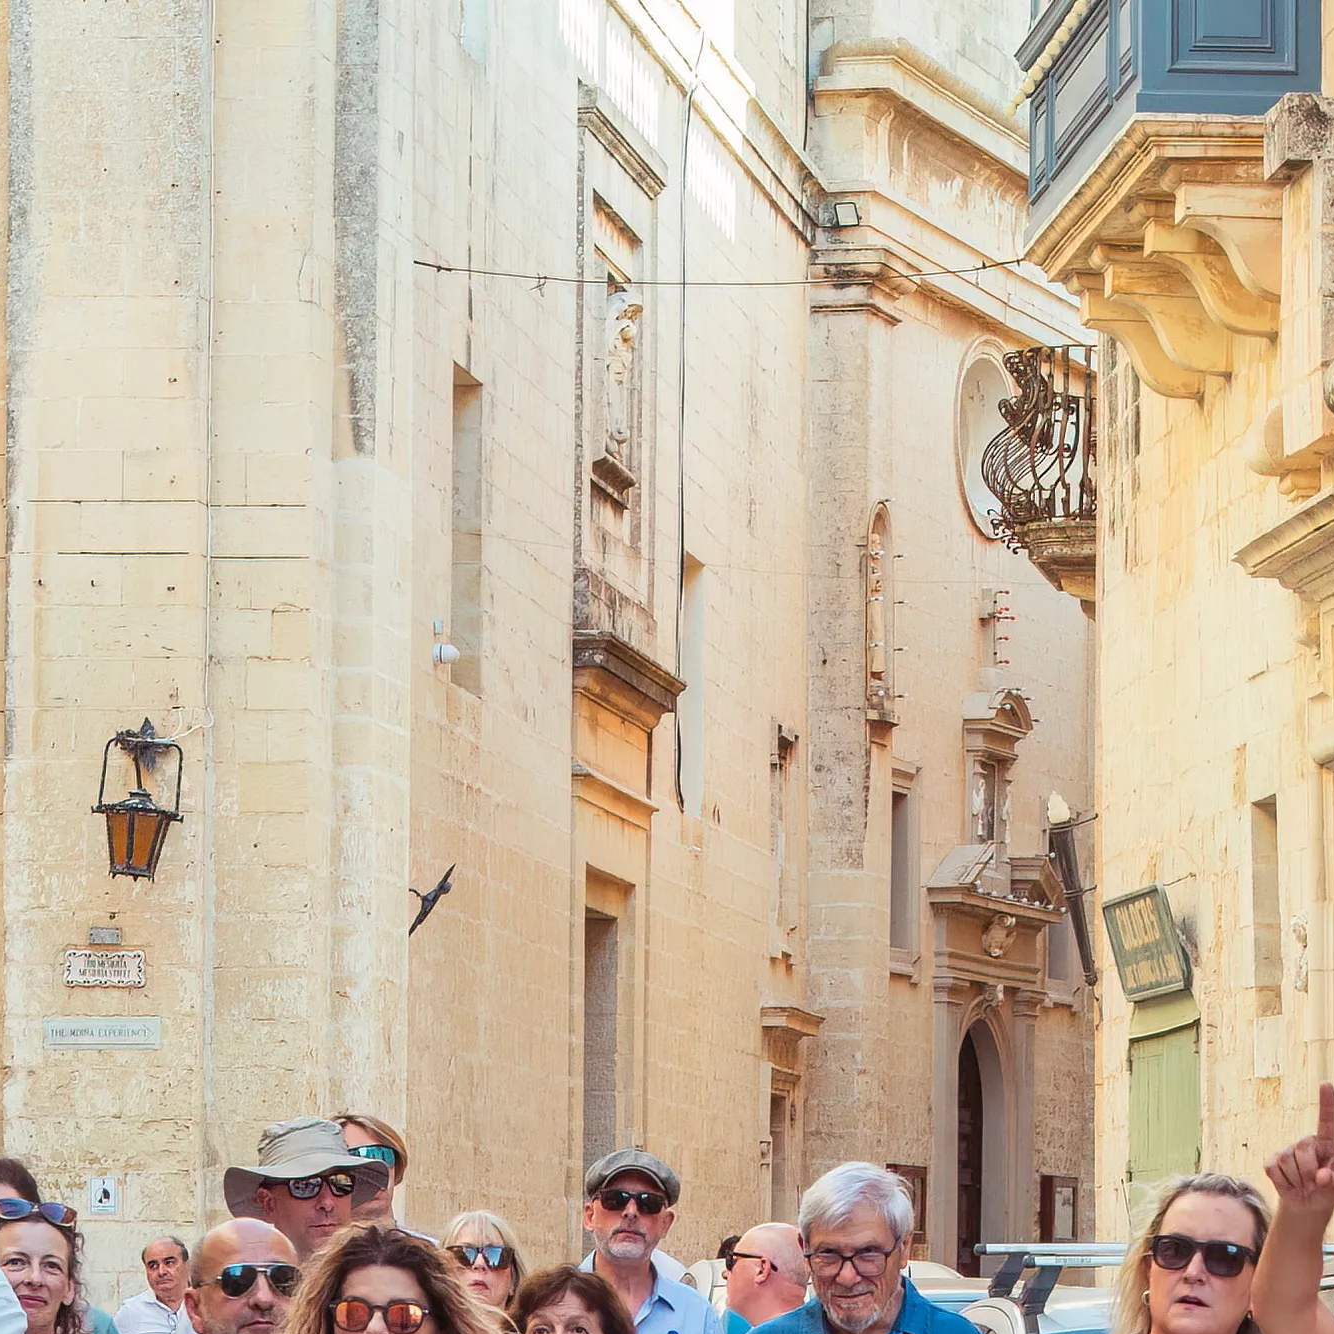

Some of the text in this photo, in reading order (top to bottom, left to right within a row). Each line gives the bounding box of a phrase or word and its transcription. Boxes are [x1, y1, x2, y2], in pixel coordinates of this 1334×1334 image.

[50, 1028, 148, 1038] THE MDINA EXPERIENCE
